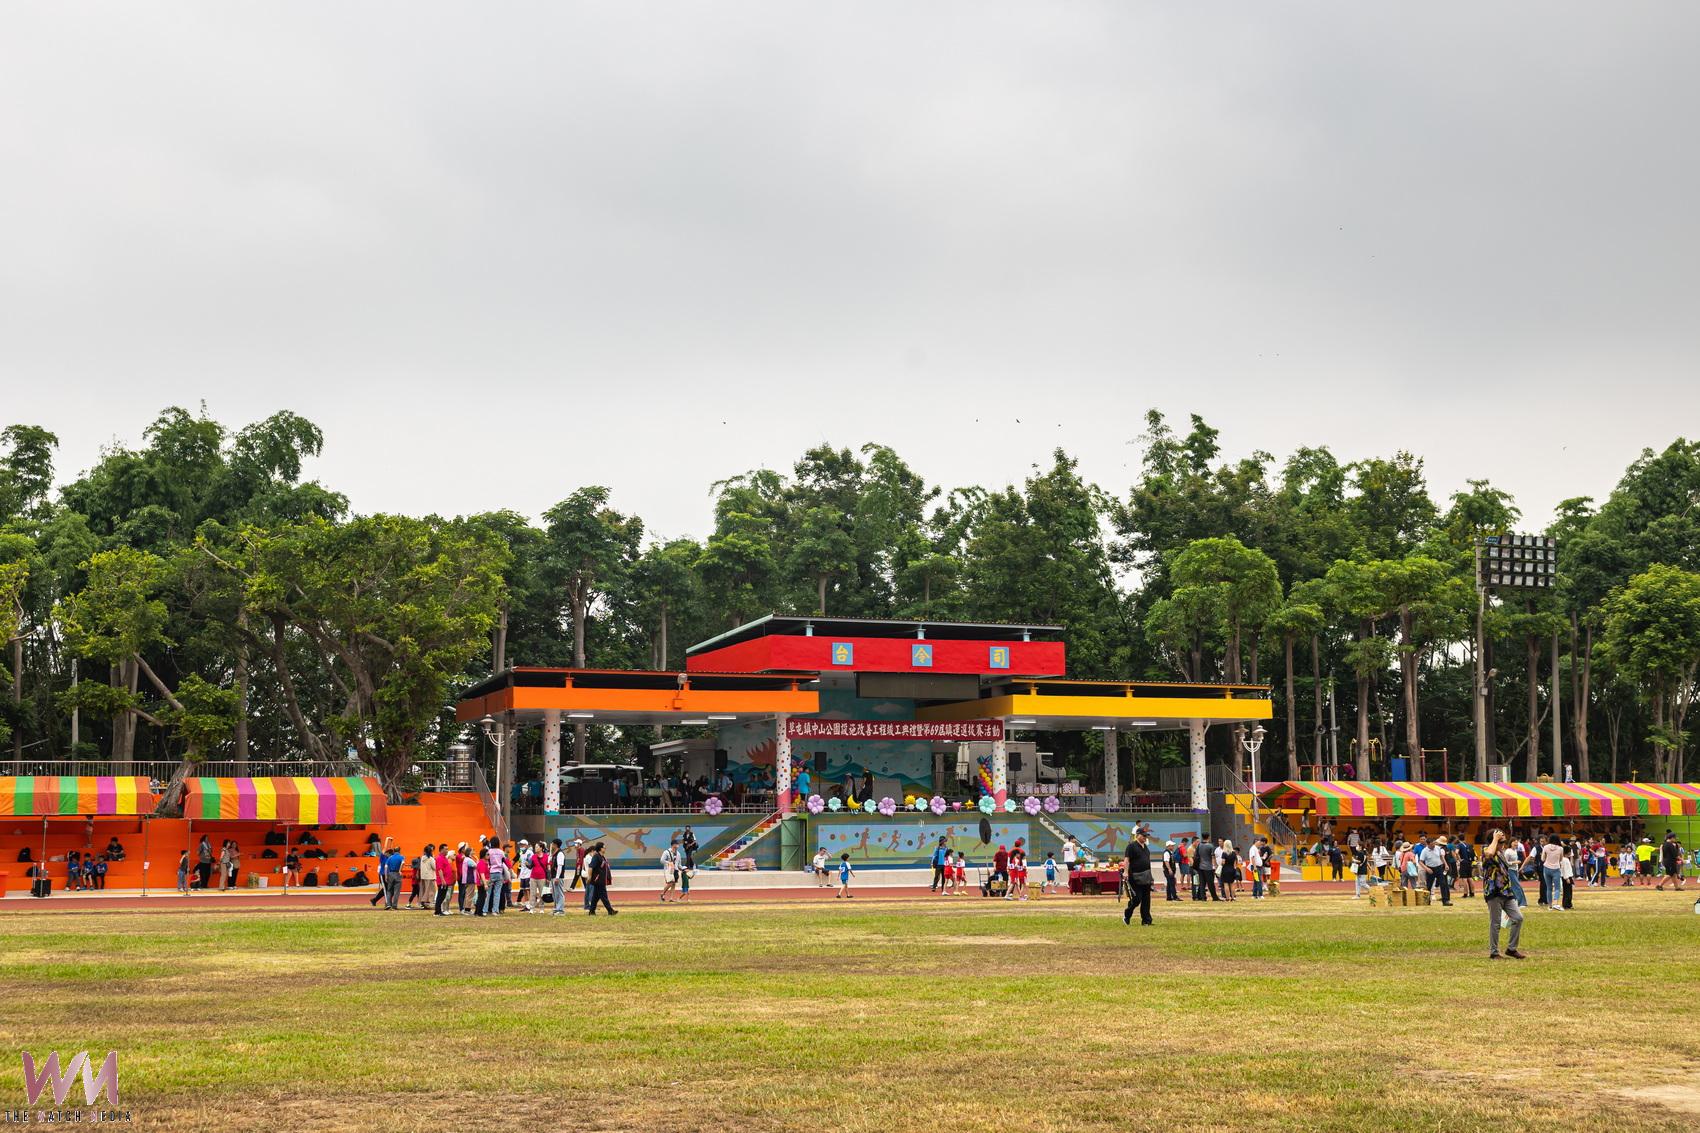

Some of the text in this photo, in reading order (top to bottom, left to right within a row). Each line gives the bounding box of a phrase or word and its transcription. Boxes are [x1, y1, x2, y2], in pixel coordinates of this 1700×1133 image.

[836, 645, 1006, 666] 台 令 司
